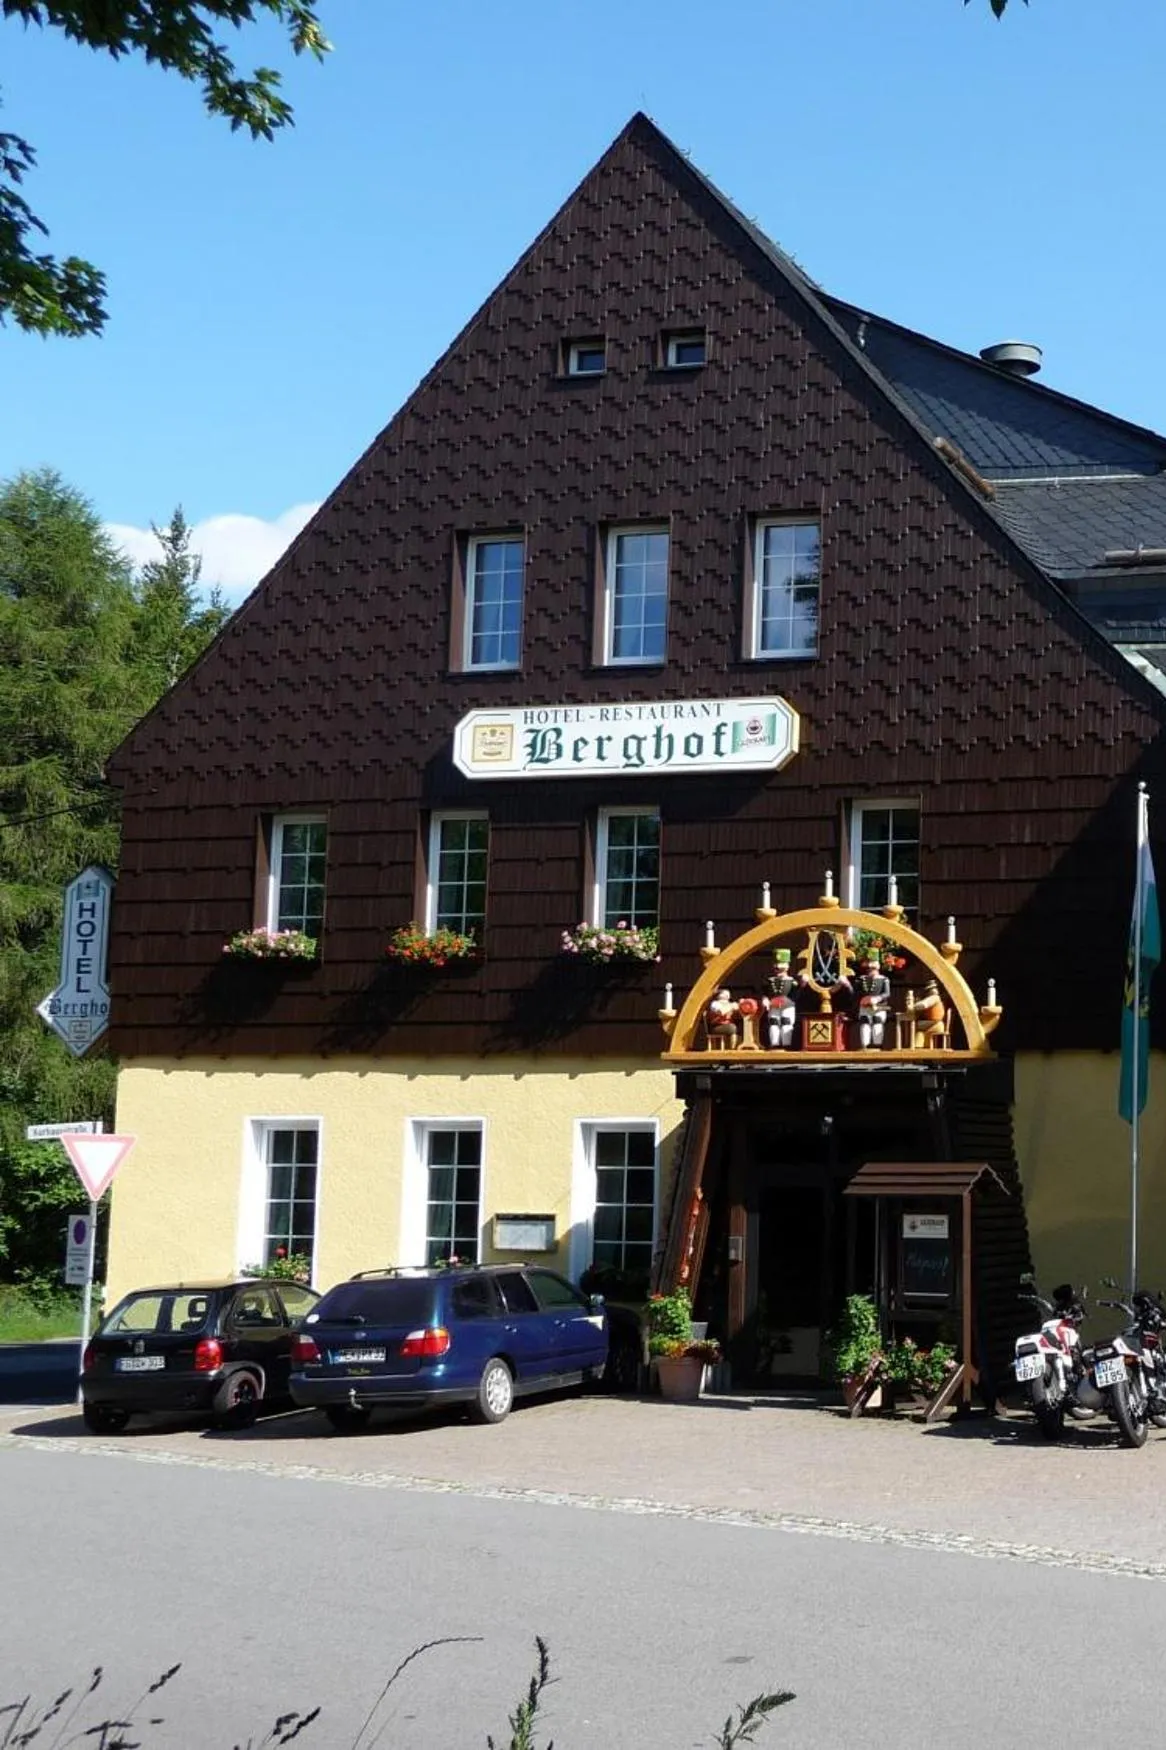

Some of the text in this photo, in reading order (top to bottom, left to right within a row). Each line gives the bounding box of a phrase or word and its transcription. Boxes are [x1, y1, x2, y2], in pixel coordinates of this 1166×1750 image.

[522, 722, 729, 769] Berghof
[75, 902, 97, 994] HOTEL
[48, 997, 109, 1018] Bergho
